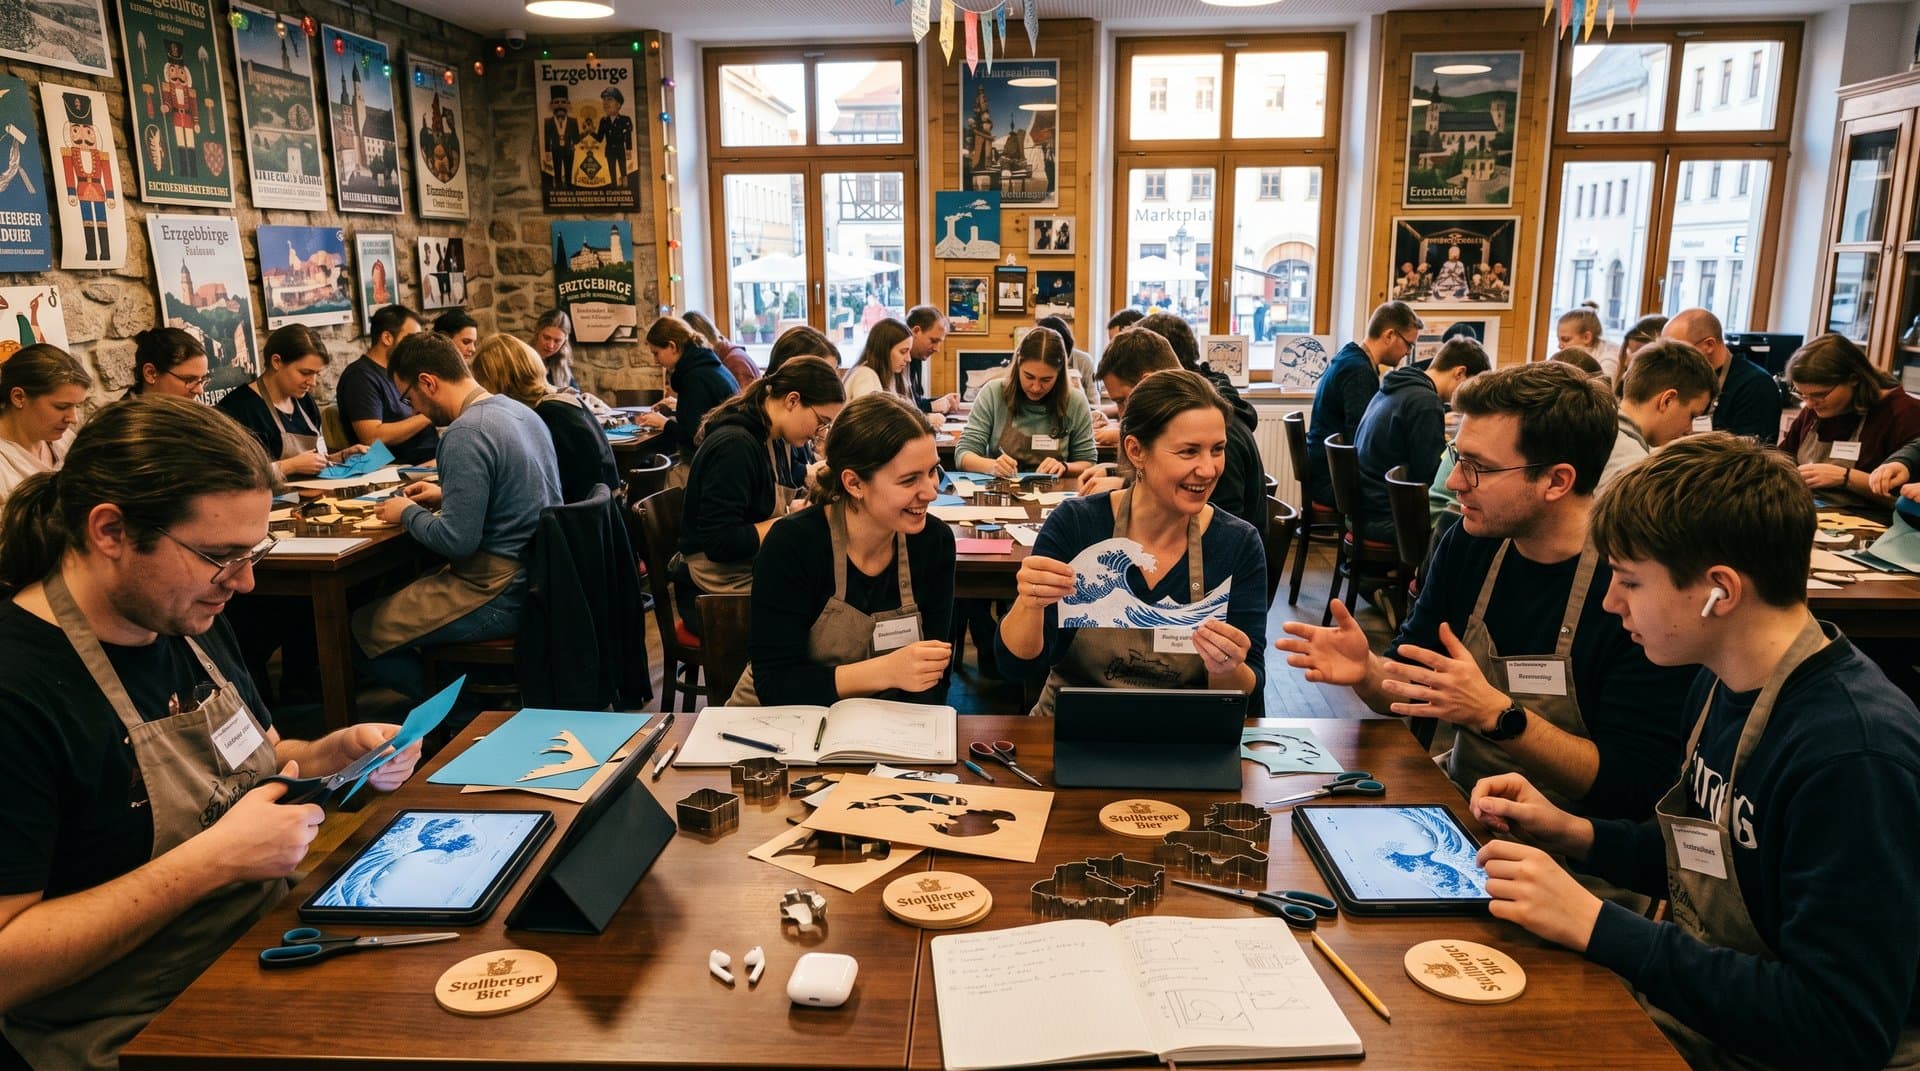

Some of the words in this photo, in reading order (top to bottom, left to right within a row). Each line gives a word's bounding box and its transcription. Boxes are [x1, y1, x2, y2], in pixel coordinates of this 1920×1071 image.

[541, 63, 628, 86] Erzgebirge
[161, 225, 229, 245] Erzgebbirge
[558, 279, 632, 296] ERZTGEBIRGE
[1135, 821, 1162, 829] Bier
[925, 901, 957, 912] Bier
[448, 975, 543, 992] Stollberger
[475, 989, 511, 1000] Bier
